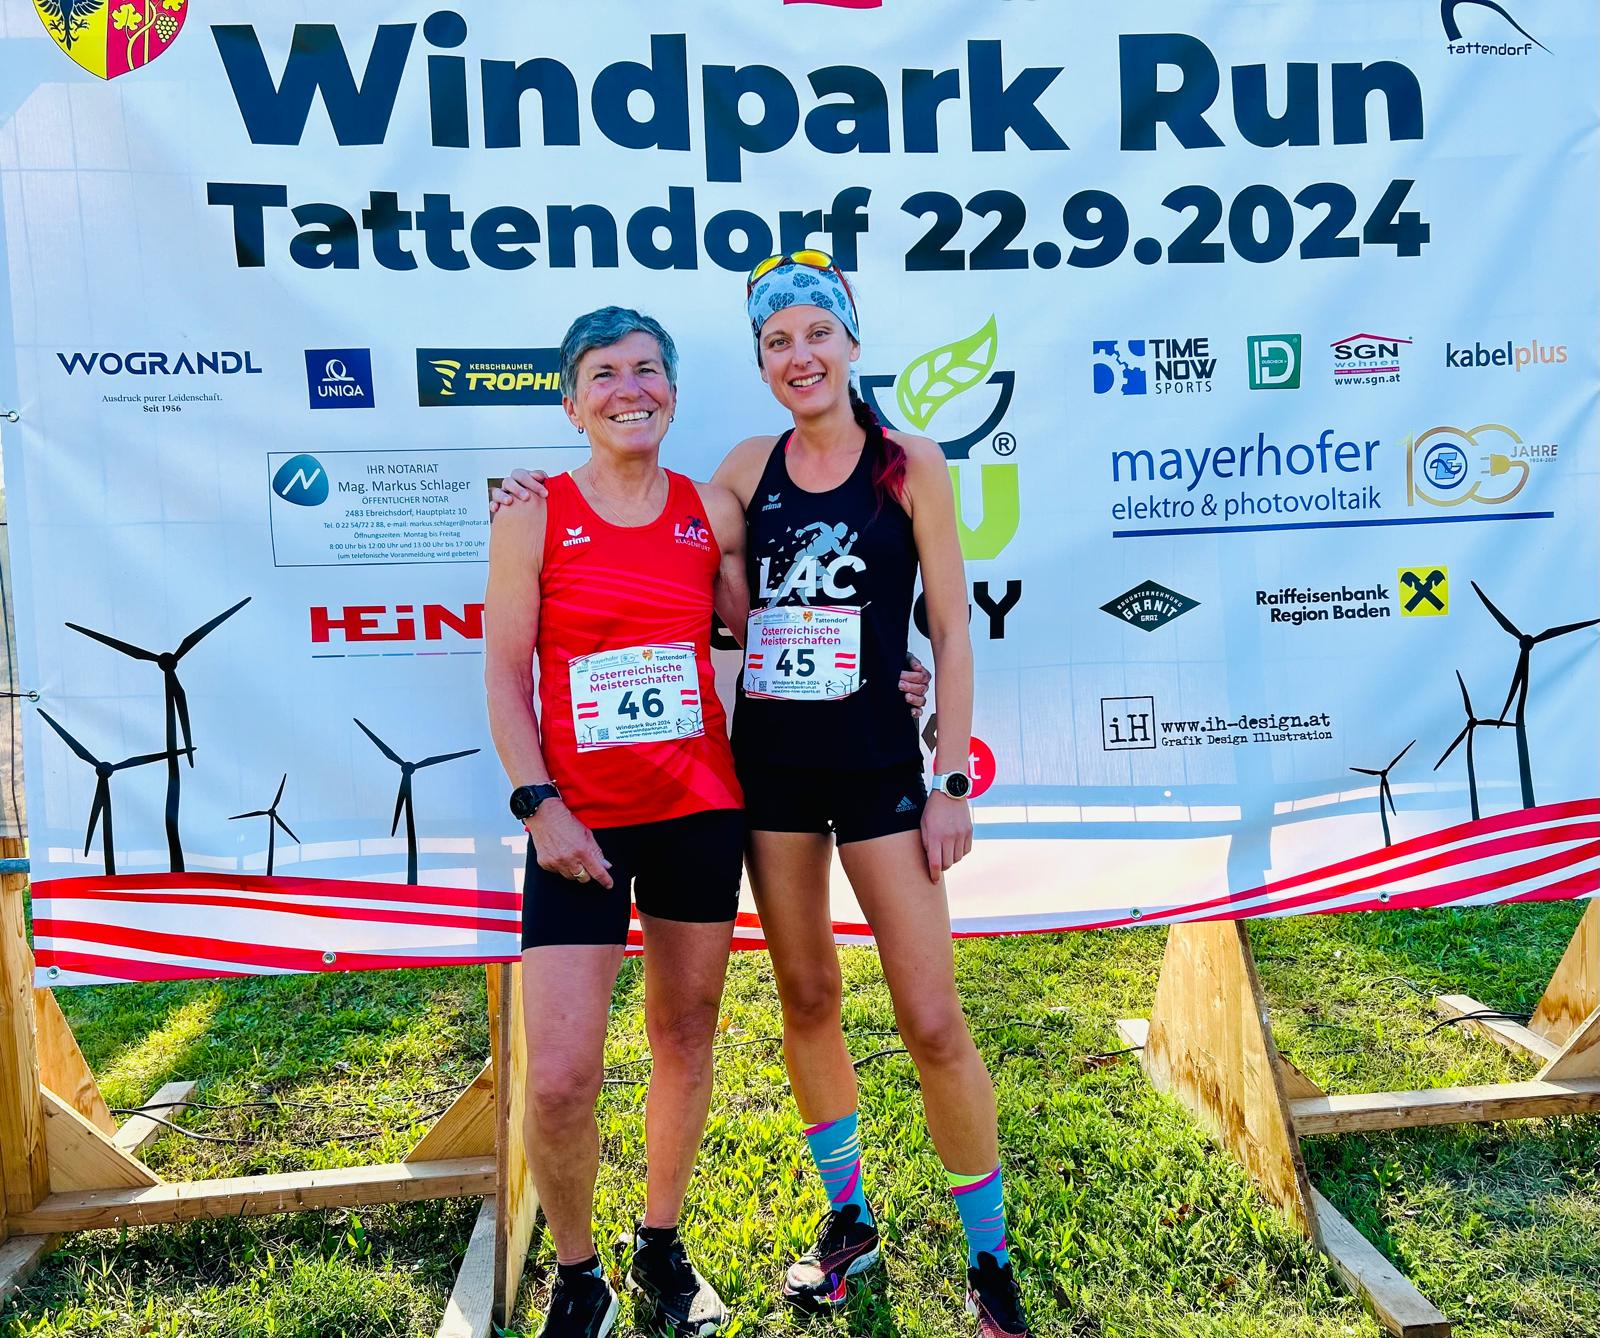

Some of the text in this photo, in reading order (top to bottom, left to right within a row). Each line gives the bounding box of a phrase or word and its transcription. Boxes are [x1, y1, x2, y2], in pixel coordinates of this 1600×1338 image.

[1447, 42, 1532, 56] tattendorf
[210, 10, 1424, 183] Windpark Run
[206, 179, 1431, 272] Tattendorf 22.9.2024
[1149, 337, 1209, 359] TIME
[1334, 343, 1399, 360] SGN
[1446, 339, 1568, 372] kabelplus
[56, 351, 263, 376] WOGRANDL
[469, 363, 534, 371] KERSCHBAUMER
[1155, 358, 1217, 381] NOW
[1334, 359, 1399, 368] wohnen
[465, 372, 560, 391] TROPHI
[1155, 381, 1212, 395] SPORTS
[1334, 373, 1401, 386] www.sgn.at
[102, 393, 223, 403] Ausdruck purer Leidenschaft.
[317, 384, 364, 398] UNIQA
[143, 404, 182, 413] Seit 1956
[1510, 444, 1559, 458] JAHRE
[366, 463, 439, 475] IHR NOTARIAT
[1112, 429, 1380, 492] mayerhofer
[338, 478, 471, 494] Mag. Markus Schlager
[361, 495, 449, 505] ÖFFENTLICHER NOTAR
[1112, 485, 1382, 521] elektro & photovoltaik
[345, 507, 468, 518] 2483 Ebreichsdorf, Hauptplatz 10
[404, 531, 427, 539] Montag
[429, 530, 437, 538] bis
[439, 530, 461, 539] Freitag
[562, 535, 591, 547] erima
[674, 523, 709, 543] LAC
[358, 542, 367, 550] bis
[387, 541, 399, 549] Uhr
[399, 541, 412, 549] und
[445, 540, 454, 548] bis
[337, 552, 351, 561] (um
[351, 551, 389, 560] telefonische
[390, 551, 436, 560] Voranmeldung
[436, 550, 450, 558] wird
[758, 555, 867, 599] LAC
[1255, 584, 1390, 606] Raiffeisenbank
[1122, 599, 1178, 620] GRANIT
[1140, 614, 1159, 622] GRAZ
[1270, 603, 1391, 626] Region Baden
[310, 603, 485, 643] HEiN
[761, 625, 841, 637] Österreichische
[760, 636, 841, 646] Meisterschaften
[655, 653, 688, 662] Tattendorf
[775, 649, 816, 678] 45
[590, 663, 682, 683] Österreichische
[590, 673, 684, 693] Meisterschaften
[617, 687, 665, 721] 46
[615, 722, 645, 731] Windpark
[1109, 713, 1151, 744] iH
[1160, 712, 1331, 733] www.ih-design.at
[1161, 730, 1333, 747] Grafik Design Illustration
